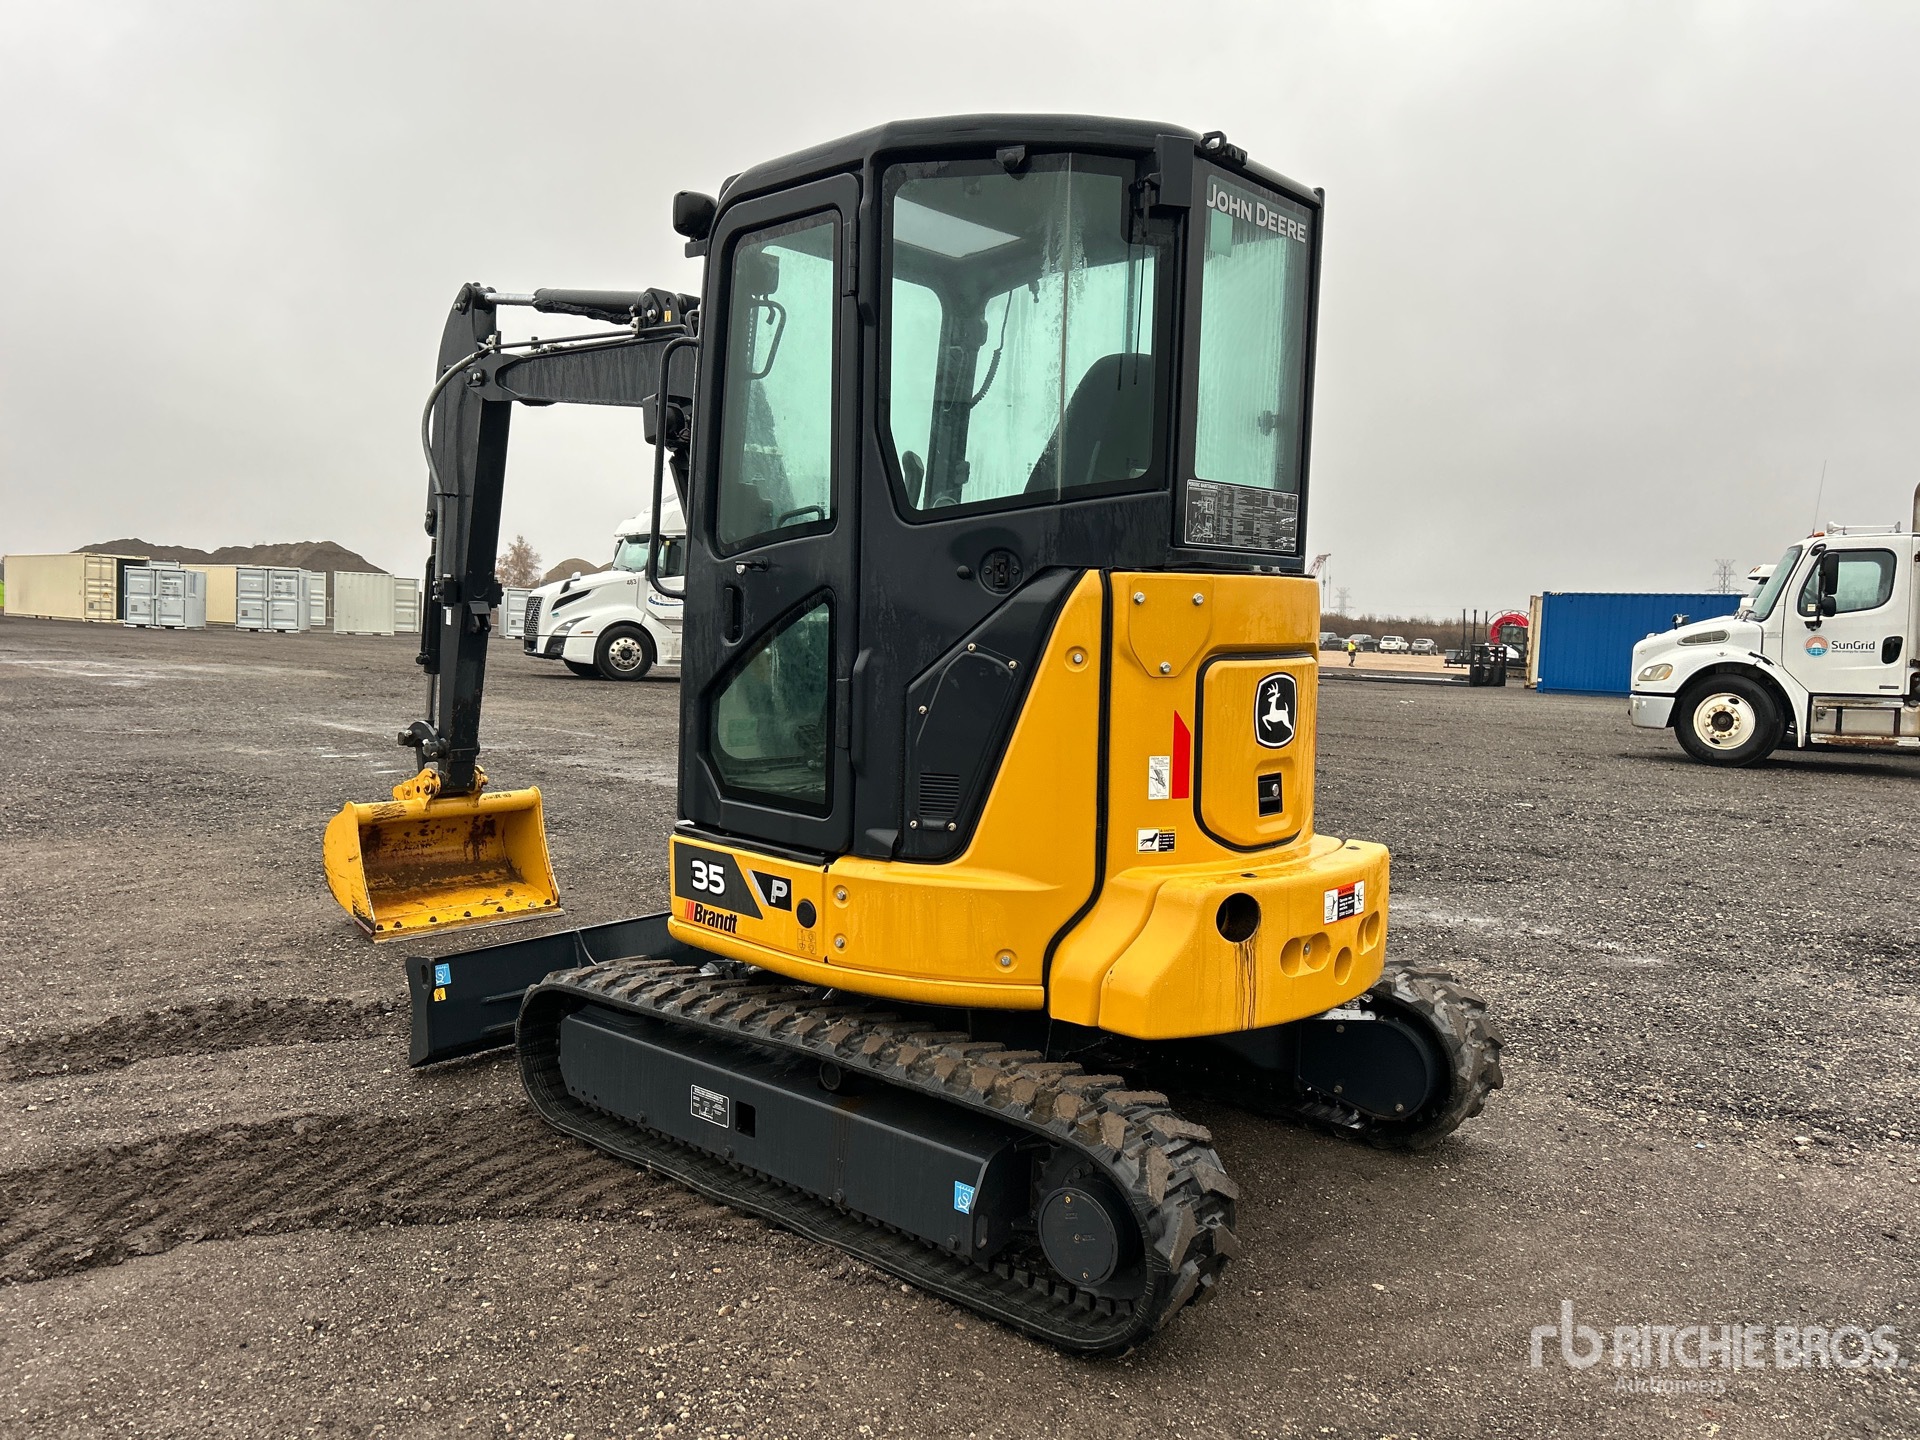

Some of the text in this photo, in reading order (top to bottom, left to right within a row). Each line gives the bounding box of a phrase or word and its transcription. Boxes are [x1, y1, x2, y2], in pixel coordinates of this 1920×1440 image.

[1206, 184, 1307, 243] JOHN DEERE
[626, 578, 637, 586] 483
[1831, 640, 1875, 650] SunGrid
[691, 859, 726, 895] 35
[770, 879, 788, 904] P
[694, 904, 738, 934] Brandt
